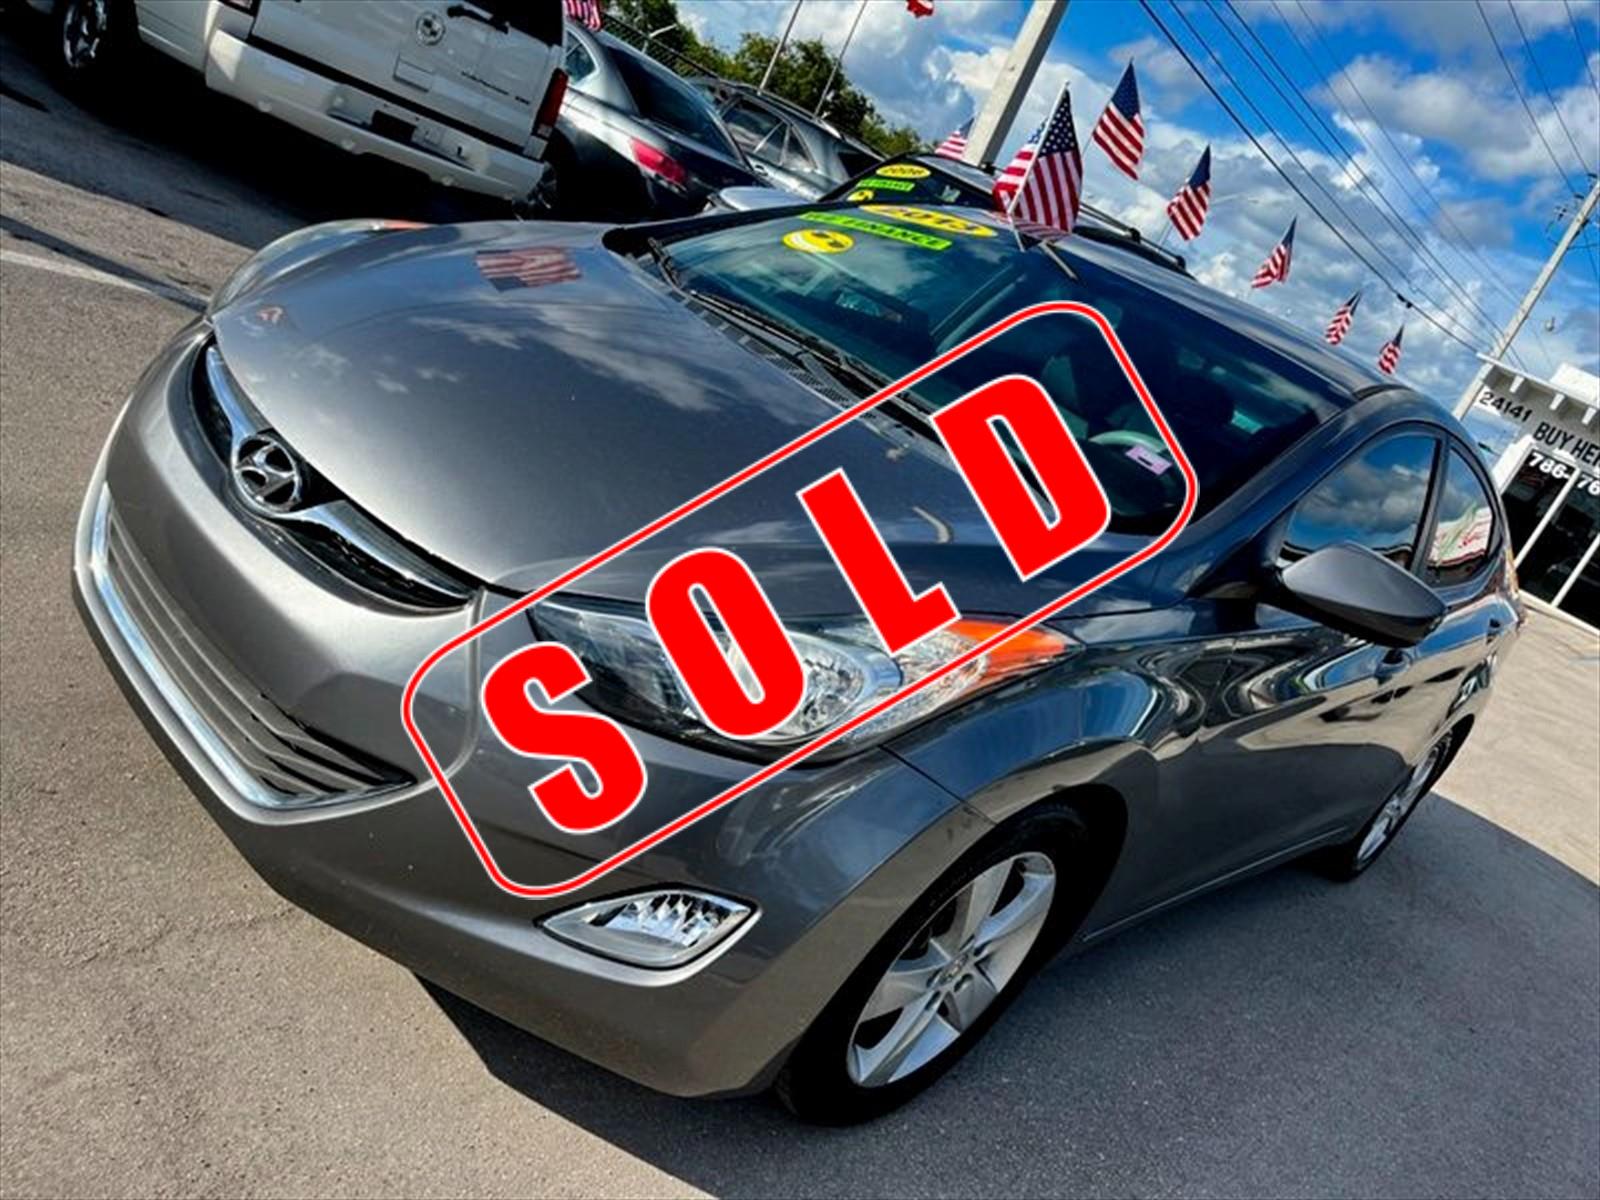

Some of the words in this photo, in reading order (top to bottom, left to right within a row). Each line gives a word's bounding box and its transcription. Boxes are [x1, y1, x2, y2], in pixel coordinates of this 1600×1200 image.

[1480, 391, 1533, 422] 24141
[1533, 421, 1575, 451] BUY
[1529, 452, 1571, 479] 786-
